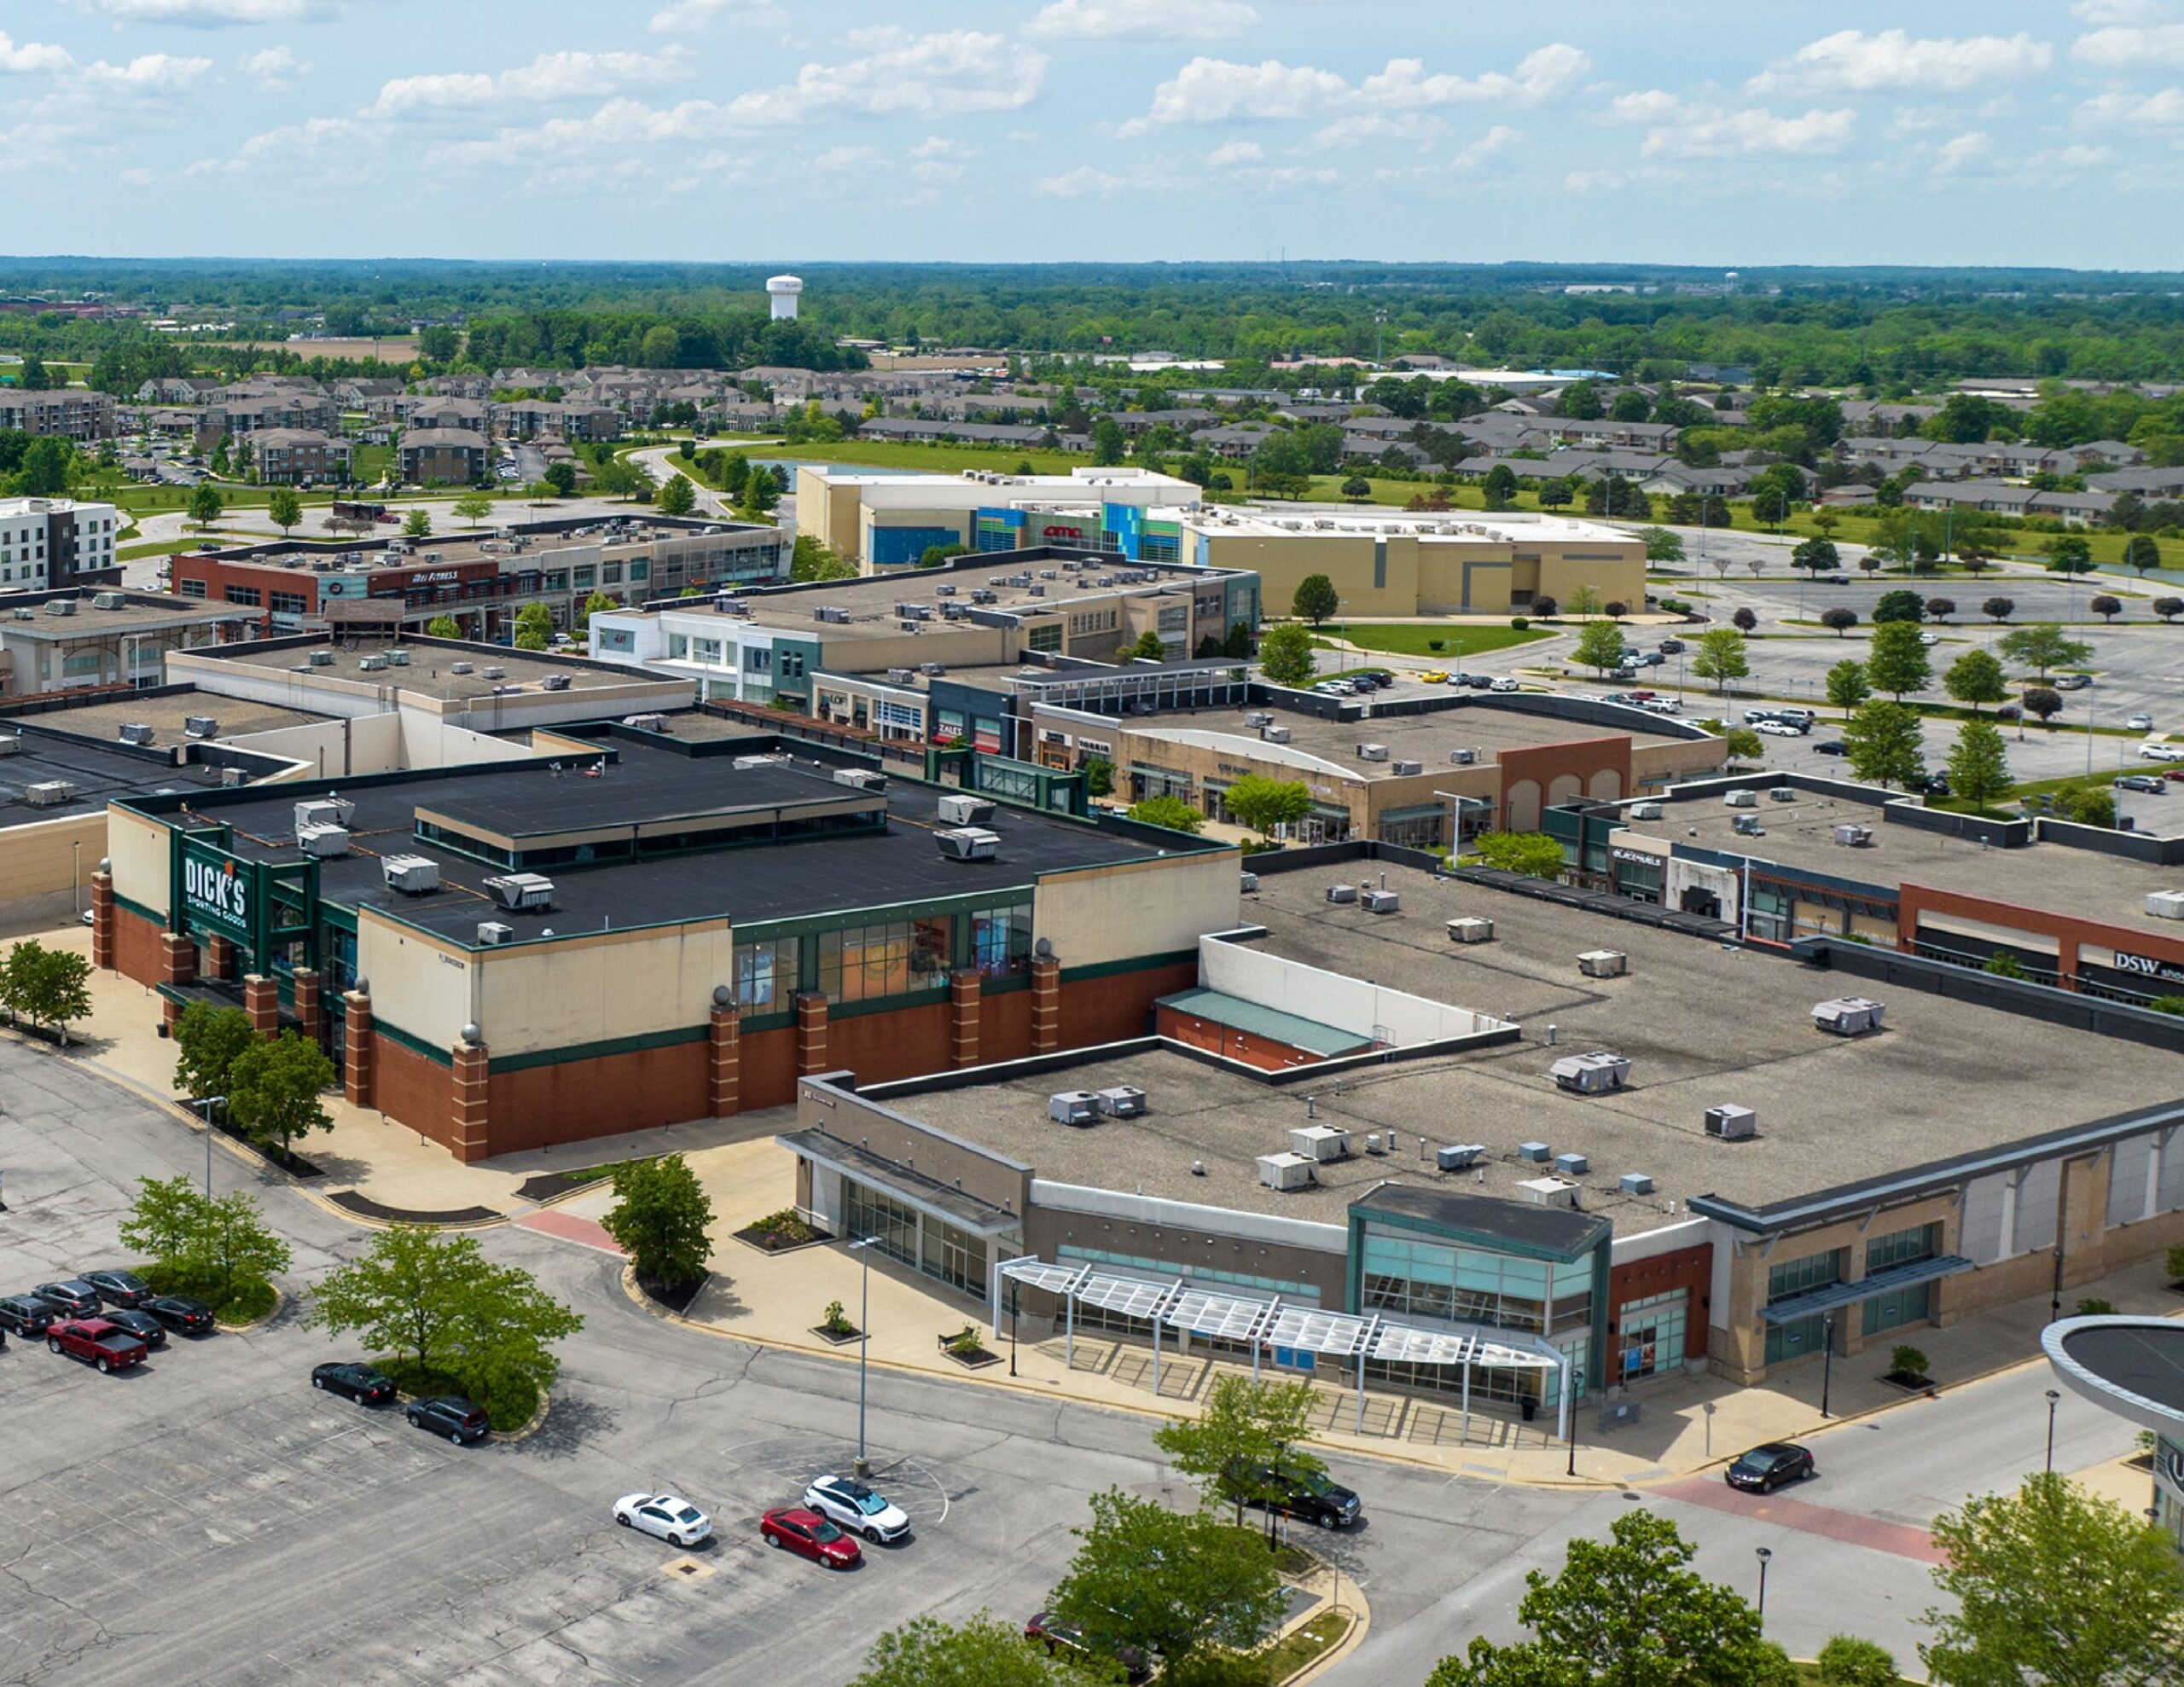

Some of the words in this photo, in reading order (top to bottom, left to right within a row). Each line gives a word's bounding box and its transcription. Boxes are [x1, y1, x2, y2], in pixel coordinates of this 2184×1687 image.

[938, 724, 963, 737] ZALES
[185, 857, 245, 916] DICK'S
[187, 893, 222, 918] SPORTING
[222, 910, 247, 929] GOODS
[2116, 952, 2160, 974] DSW
